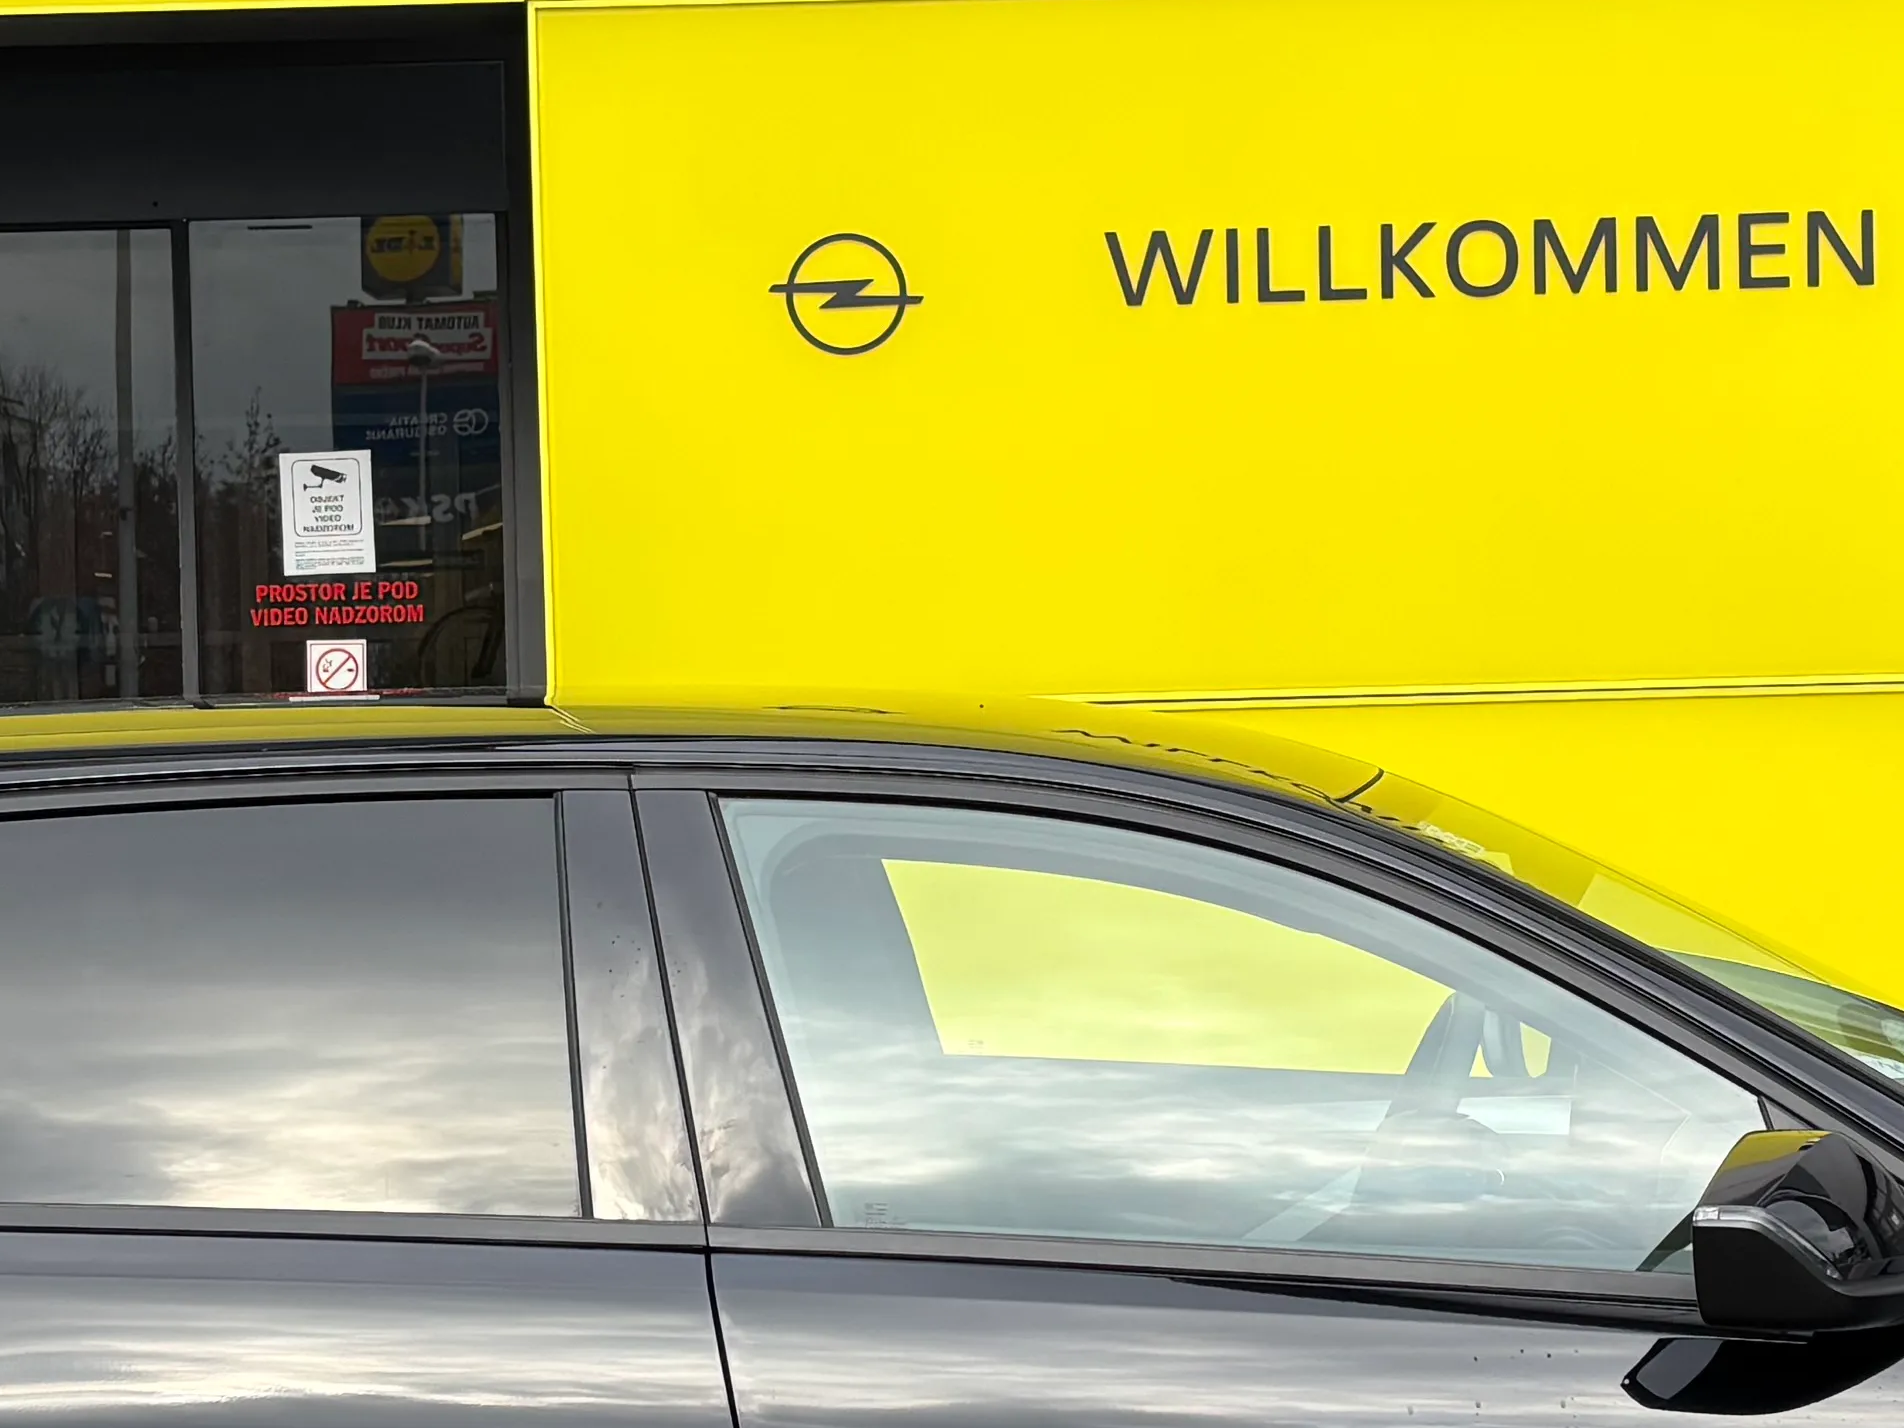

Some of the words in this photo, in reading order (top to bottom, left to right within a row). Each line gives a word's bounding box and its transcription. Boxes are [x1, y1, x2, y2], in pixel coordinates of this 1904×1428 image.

[1104, 209, 1875, 307] WILLKOMMEN
[254, 582, 346, 604] PROSTOR
[352, 582, 373, 601] JE
[377, 581, 421, 601] POD
[250, 606, 310, 627] VIDEO
[314, 604, 425, 625] NADZOROM
